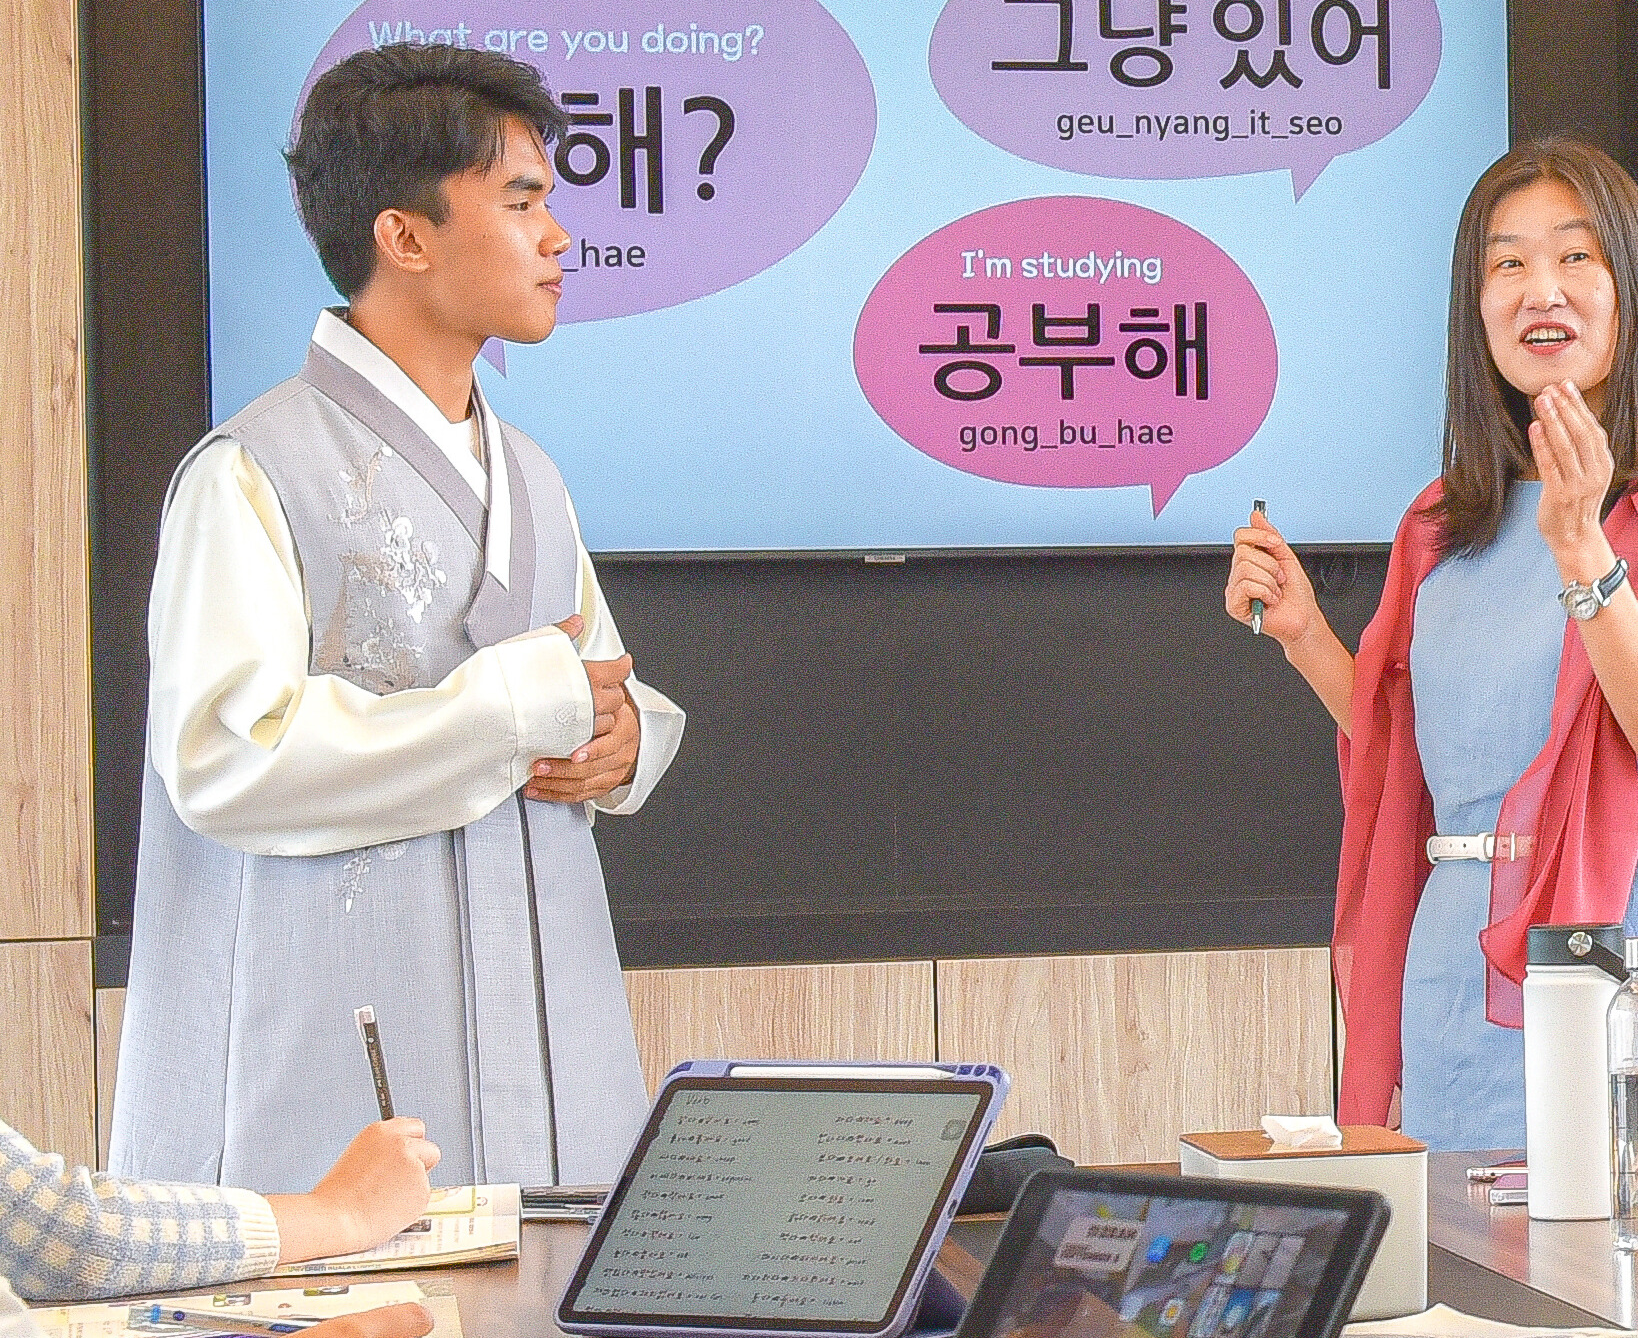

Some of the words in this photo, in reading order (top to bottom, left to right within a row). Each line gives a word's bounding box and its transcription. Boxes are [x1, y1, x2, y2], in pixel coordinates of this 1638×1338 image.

[368, 20, 472, 49] What
[484, 28, 549, 53] are
[561, 30, 629, 60] you
[641, 22, 765, 61] doing?
[1056, 109, 1343, 141] geu_nyang_it_seo
[961, 249, 1012, 278] I'm
[1021, 251, 1163, 283] studying
[918, 301, 1209, 402] 공부해
[959, 418, 1174, 452] gong_bu_hae
